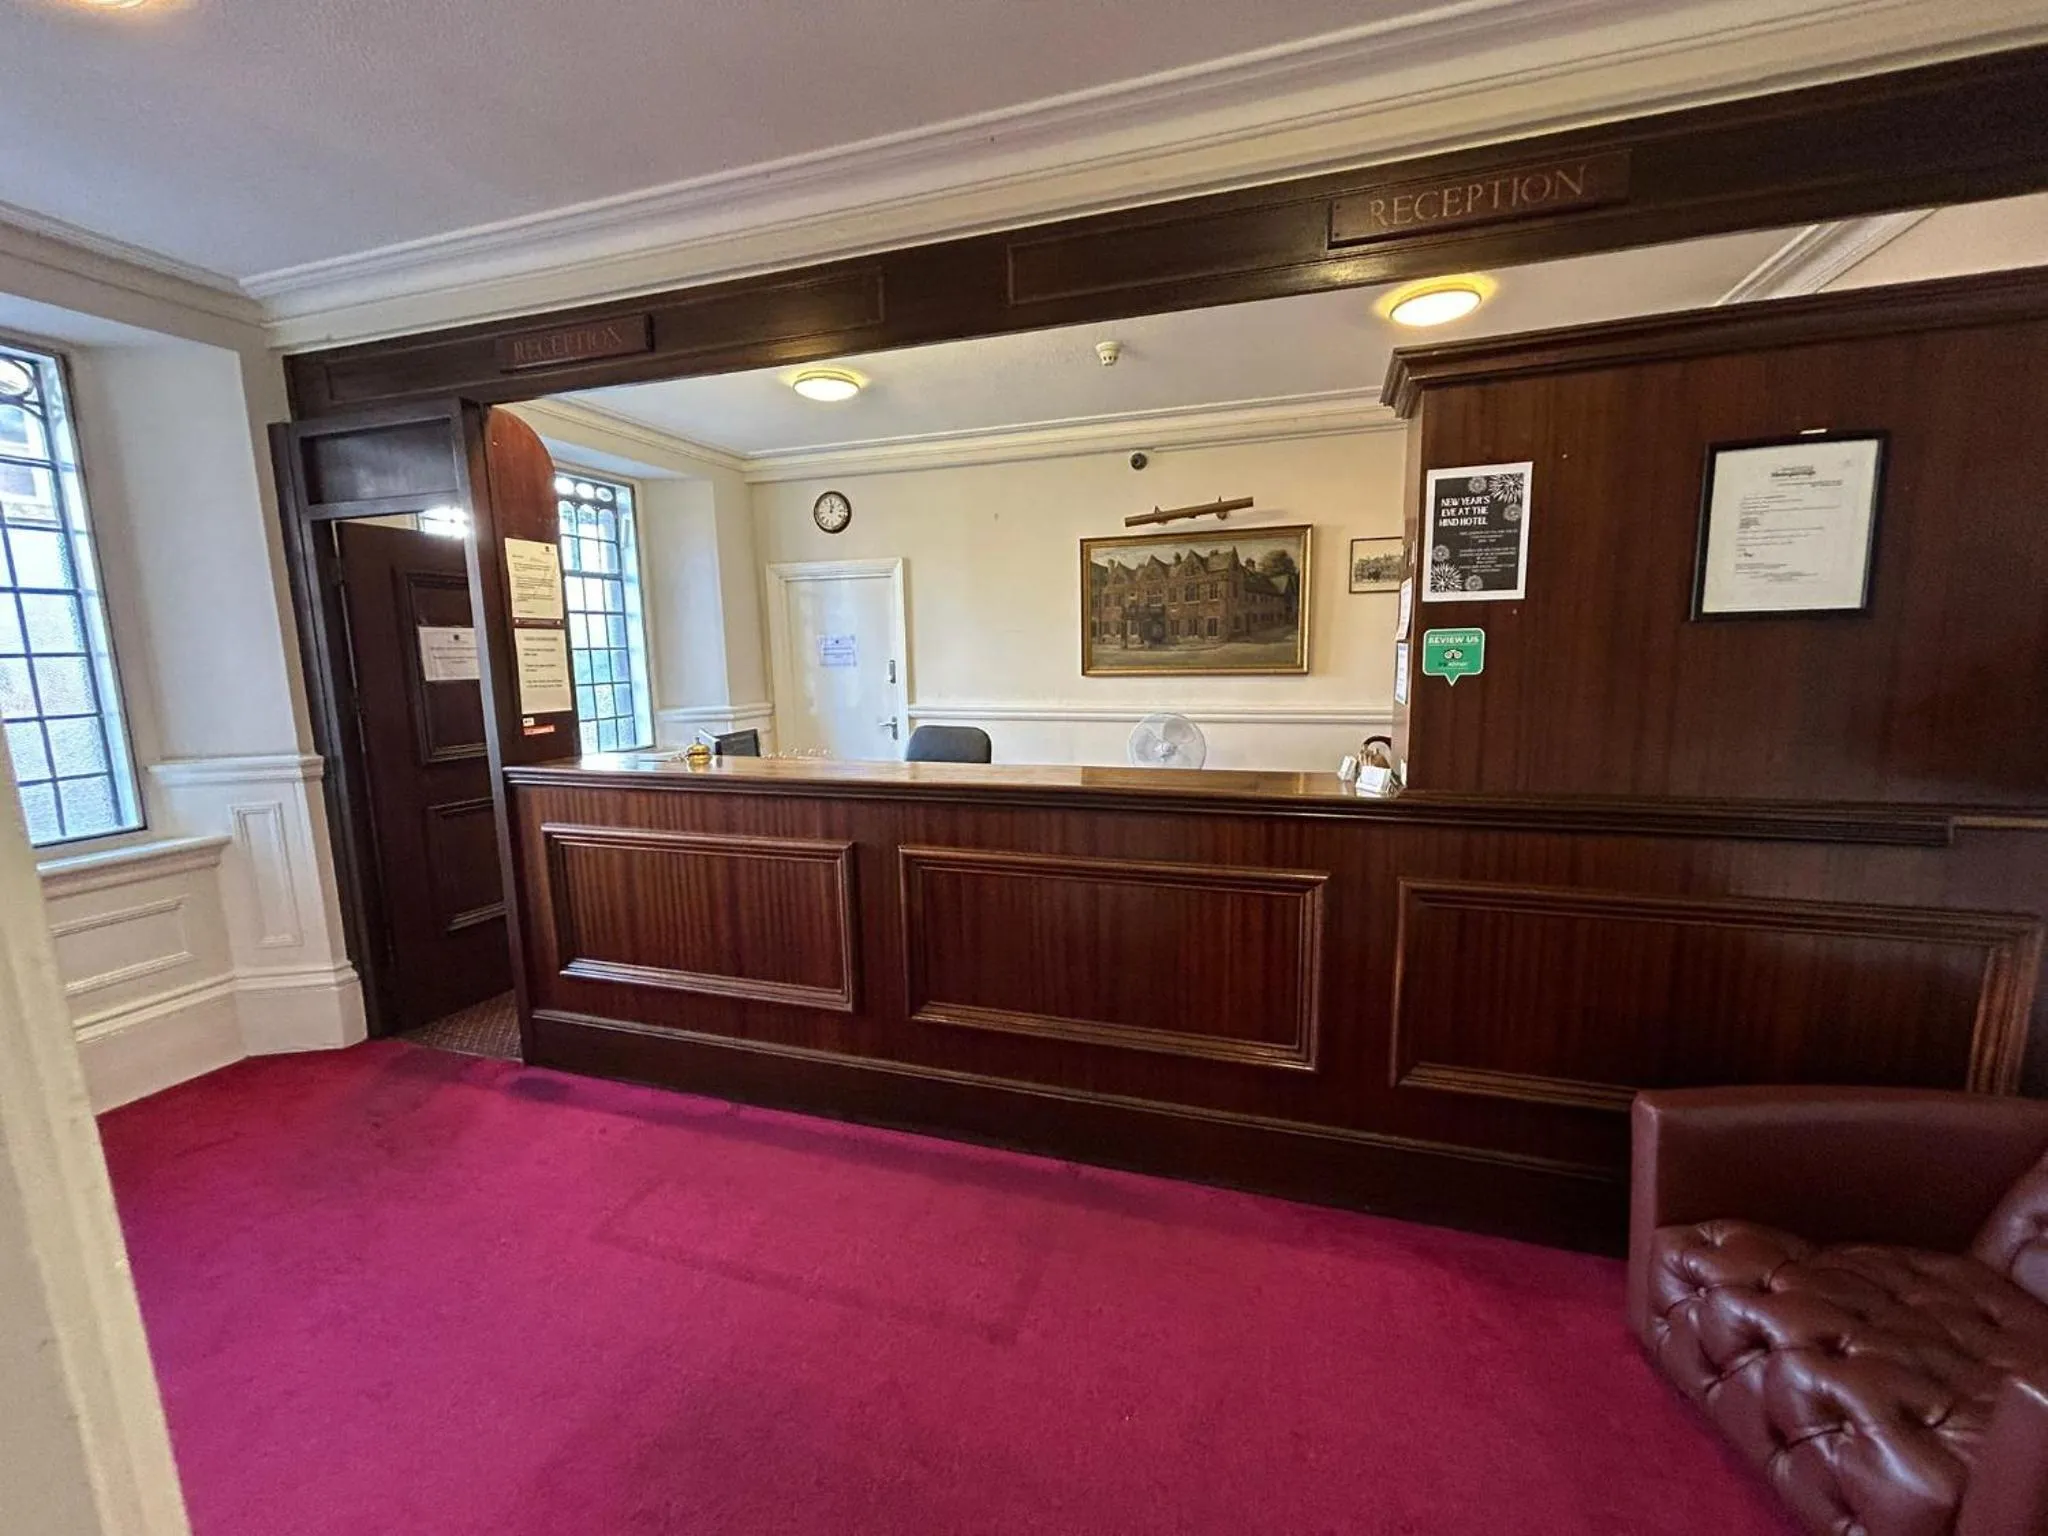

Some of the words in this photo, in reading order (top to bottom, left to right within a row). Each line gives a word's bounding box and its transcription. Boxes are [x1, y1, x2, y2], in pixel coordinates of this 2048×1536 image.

[1369, 164, 1587, 228] RECEPTION
[513, 326, 622, 362] RECEPTION
[1441, 497, 1460, 506] NEW
[1458, 506, 1471, 516] AT
[1472, 505, 1489, 515] THE
[1460, 516, 1488, 526] HOTEL
[1428, 636, 1464, 644] REVIEW
[1466, 635, 1480, 643] US
